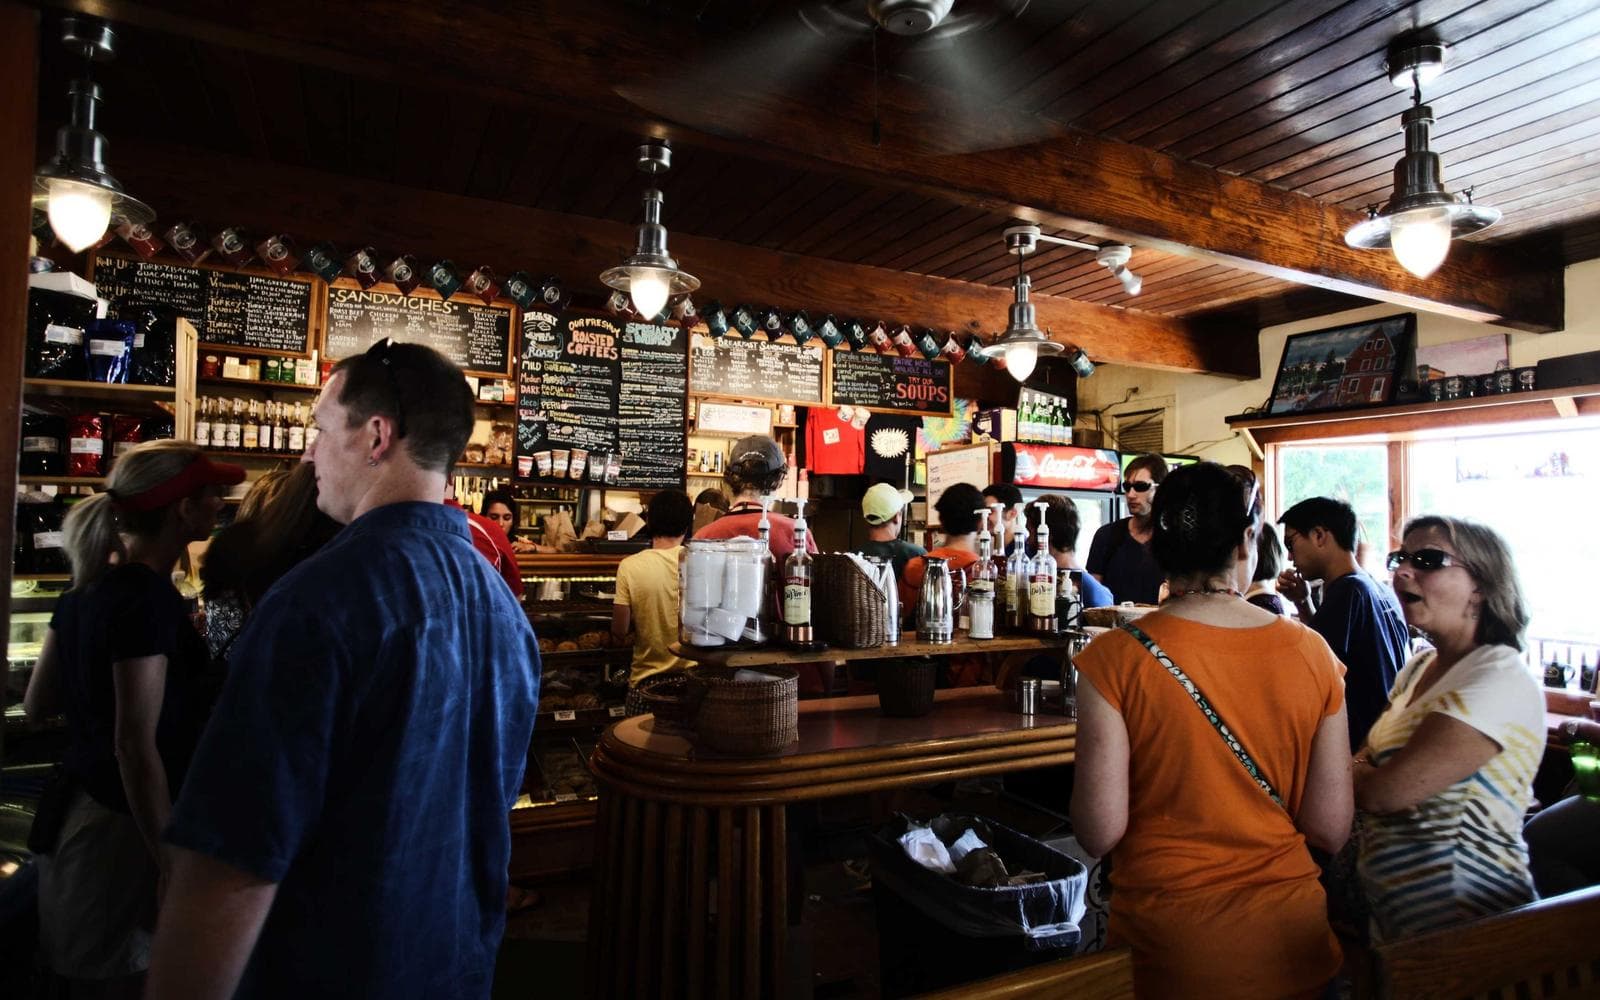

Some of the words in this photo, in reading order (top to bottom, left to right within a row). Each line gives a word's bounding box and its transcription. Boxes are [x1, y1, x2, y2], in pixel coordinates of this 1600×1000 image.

[335, 289, 453, 314] SANDWICHES
[406, 314, 425, 322] TUNA
[568, 318, 585, 331] OUR
[585, 318, 621, 339] FRESHLY
[572, 330, 615, 347] ROASTED
[717, 336, 759, 349] BREAKFAST
[759, 340, 802, 355] SANDWICHES
[528, 346, 562, 360] ROAST
[567, 342, 618, 360] COFFEES
[521, 360, 542, 372] MILD
[908, 376, 921, 385] TRY
[922, 377, 935, 386] OUR
[520, 385, 540, 395] DARK
[541, 384, 565, 393] PAPUA
[896, 383, 948, 403] SOUPS
[619, 450, 633, 458] TEA
